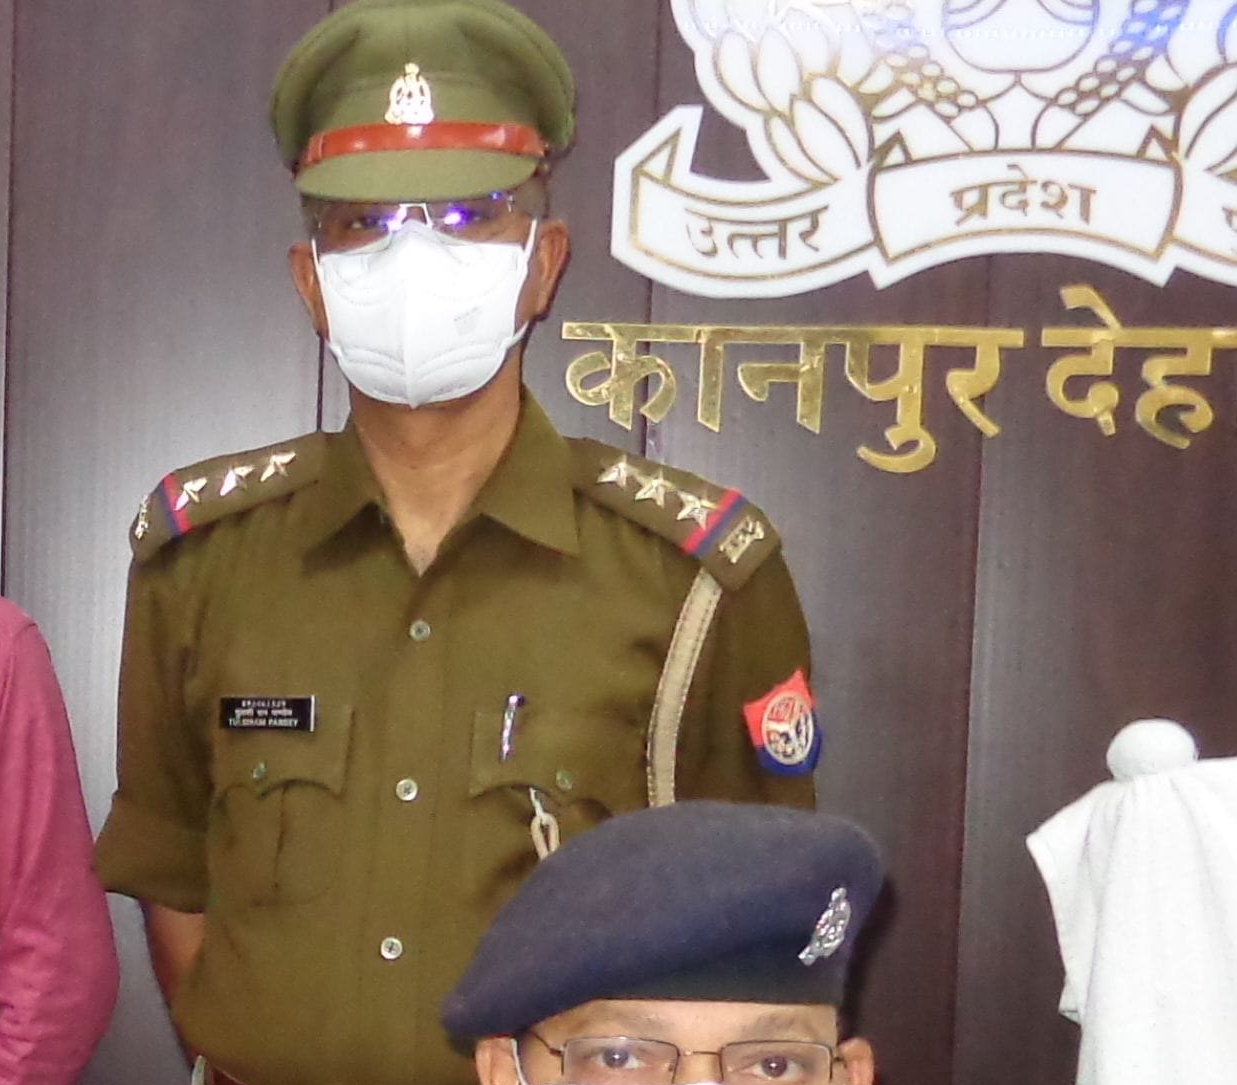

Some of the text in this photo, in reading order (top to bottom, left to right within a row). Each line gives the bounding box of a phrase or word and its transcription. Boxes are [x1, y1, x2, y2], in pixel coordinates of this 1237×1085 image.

[684, 163, 1097, 260] उत्तर प्रदेश
[561, 284, 1237, 474] कानपुर देह
